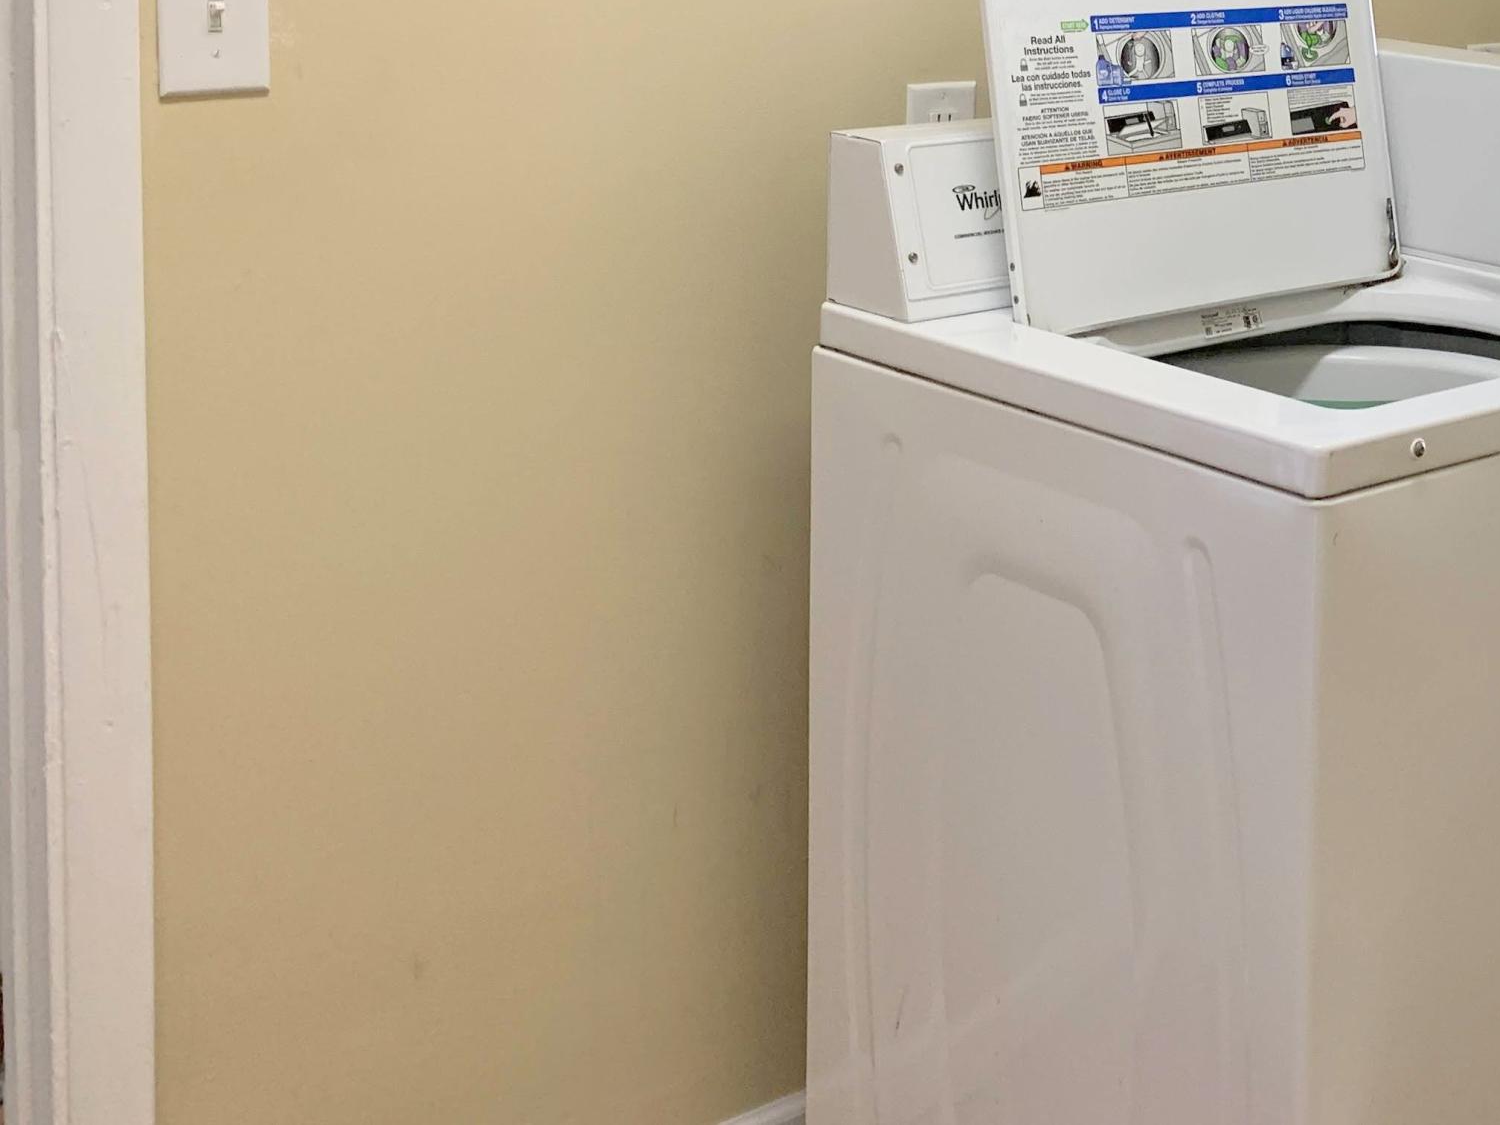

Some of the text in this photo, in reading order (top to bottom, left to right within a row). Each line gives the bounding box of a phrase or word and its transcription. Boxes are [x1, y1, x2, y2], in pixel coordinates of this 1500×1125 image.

[1190, 13, 1197, 25] 2
[1279, 8, 1285, 20] 3
[1094, 18, 1099, 30] 1
[1030, 35, 1066, 45] Read All
[1023, 45, 1075, 56] Instructions
[1011, 74, 1025, 83] Lea
[1041, 71, 1070, 81] cuidado
[1071, 69, 1092, 79] todas
[1286, 74, 1292, 85] 6
[1021, 83, 1033, 92] las
[1196, 81, 1203, 94] 5
[1101, 89, 1108, 102] 4
[1289, 135, 1328, 147] ADVERTENCIA
[1165, 147, 1216, 160] AVERTISSEMENT
[1071, 159, 1103, 170] WARNING
